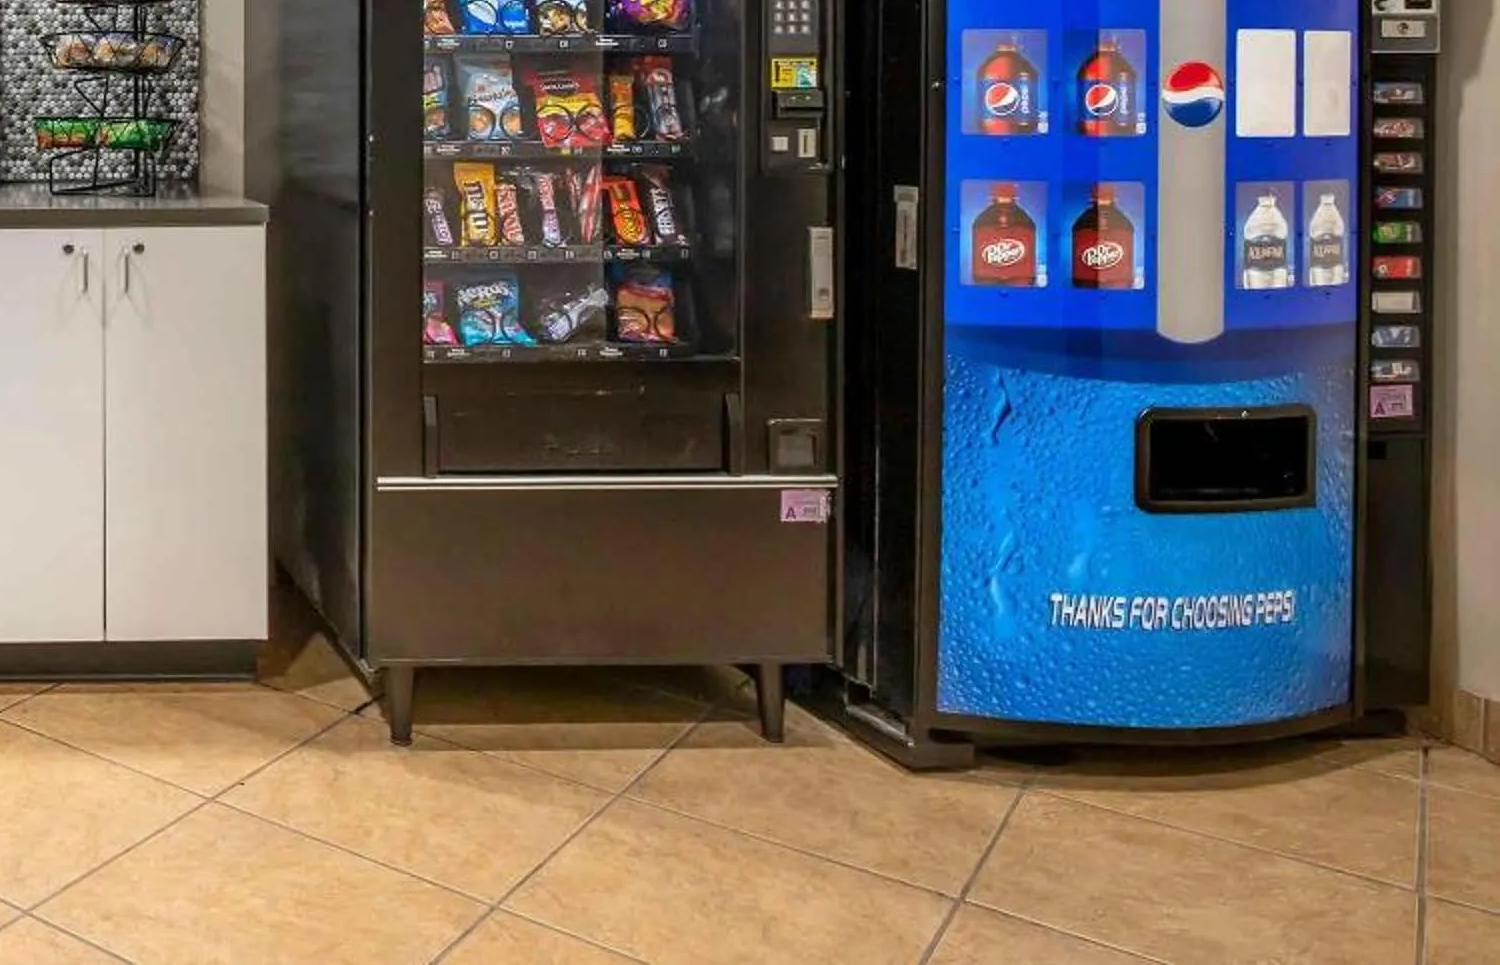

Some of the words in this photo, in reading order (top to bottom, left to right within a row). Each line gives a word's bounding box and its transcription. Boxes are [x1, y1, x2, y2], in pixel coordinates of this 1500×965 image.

[785, 506, 797, 520] A
[1050, 592, 1126, 628] THANKS
[1129, 596, 1169, 630] FOR
[1171, 593, 1252, 630] CHOOSING
